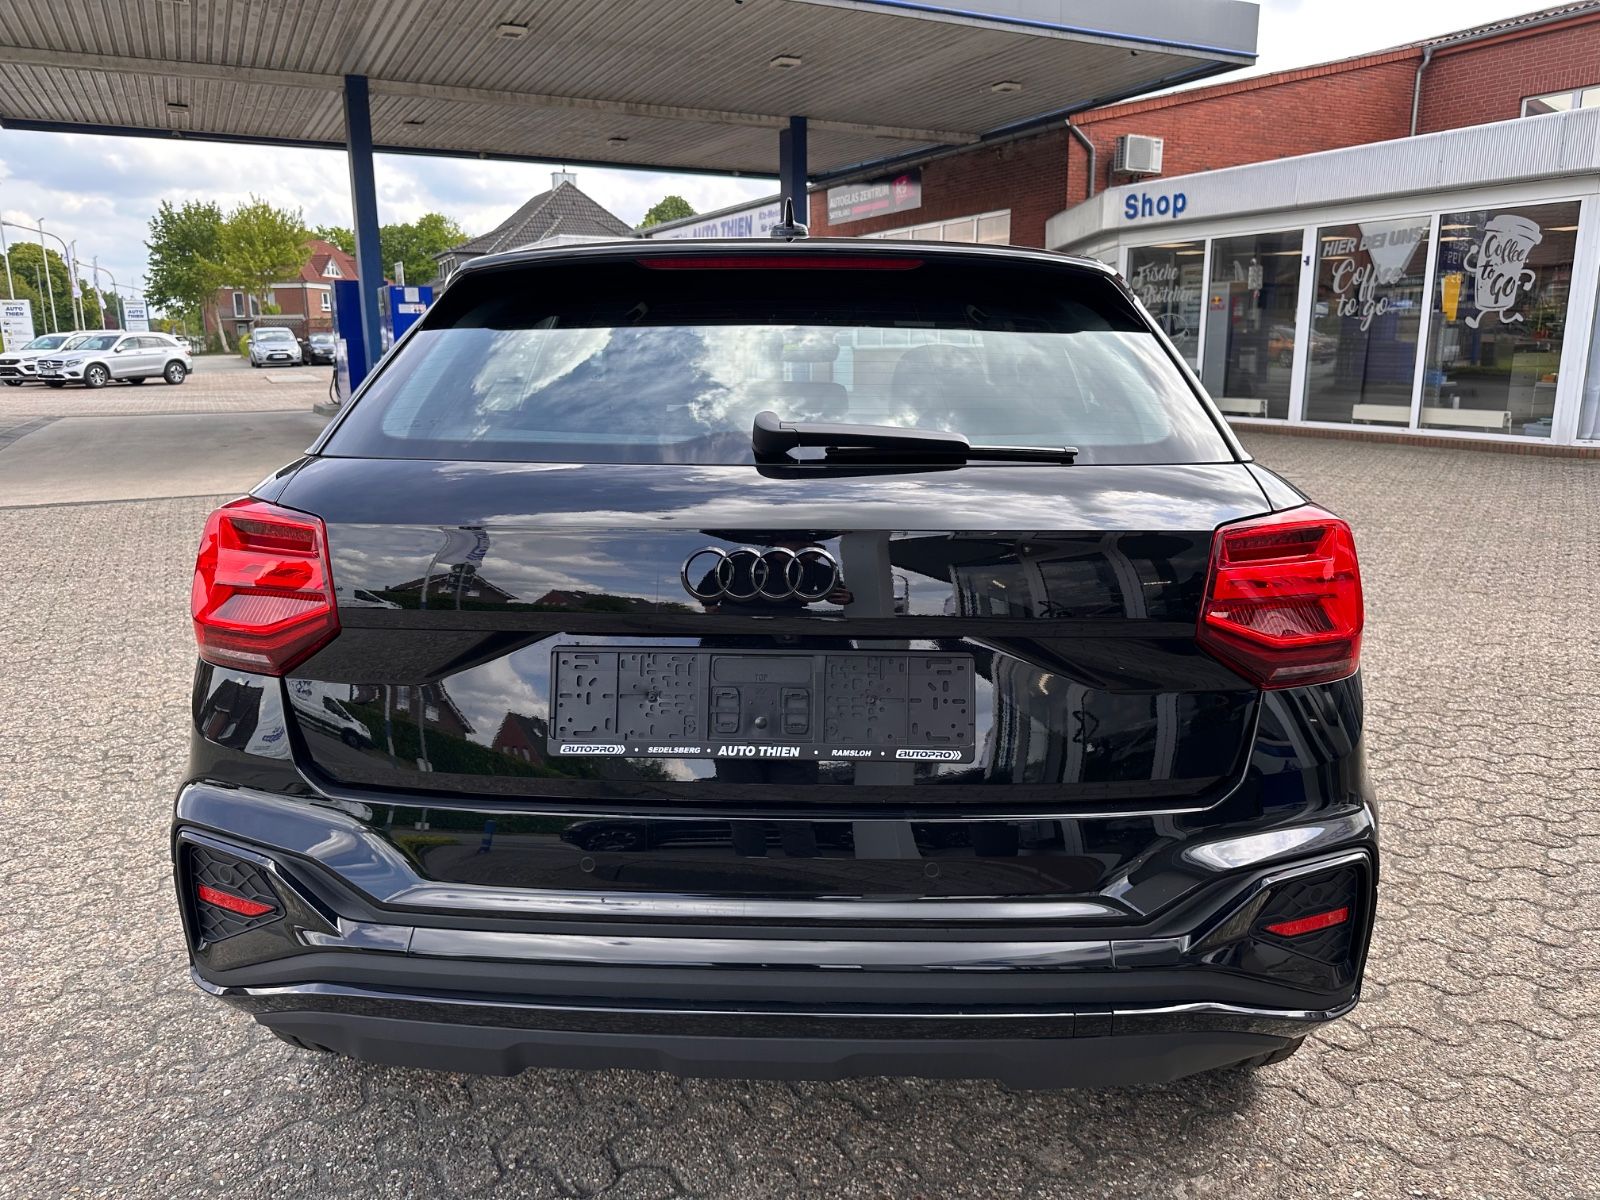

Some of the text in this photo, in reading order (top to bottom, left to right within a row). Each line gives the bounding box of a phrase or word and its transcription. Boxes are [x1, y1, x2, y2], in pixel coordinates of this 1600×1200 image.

[1124, 192, 1187, 219] Shop
[693, 223, 718, 238] AUTO
[720, 215, 753, 237] THIEN
[1323, 226, 1423, 257] HIER BEI UNS
[1484, 234, 1526, 264] Coffee
[1132, 261, 1179, 290] Frische
[1331, 258, 1404, 302] Coffee
[1479, 259, 1496, 281] to
[1336, 294, 1389, 332] to go
[647, 746, 701, 754] SEDELSBERG
[717, 745, 756, 756] AUTO
[758, 746, 800, 757] THIEN
[831, 749, 872, 757] RAMSLOH
